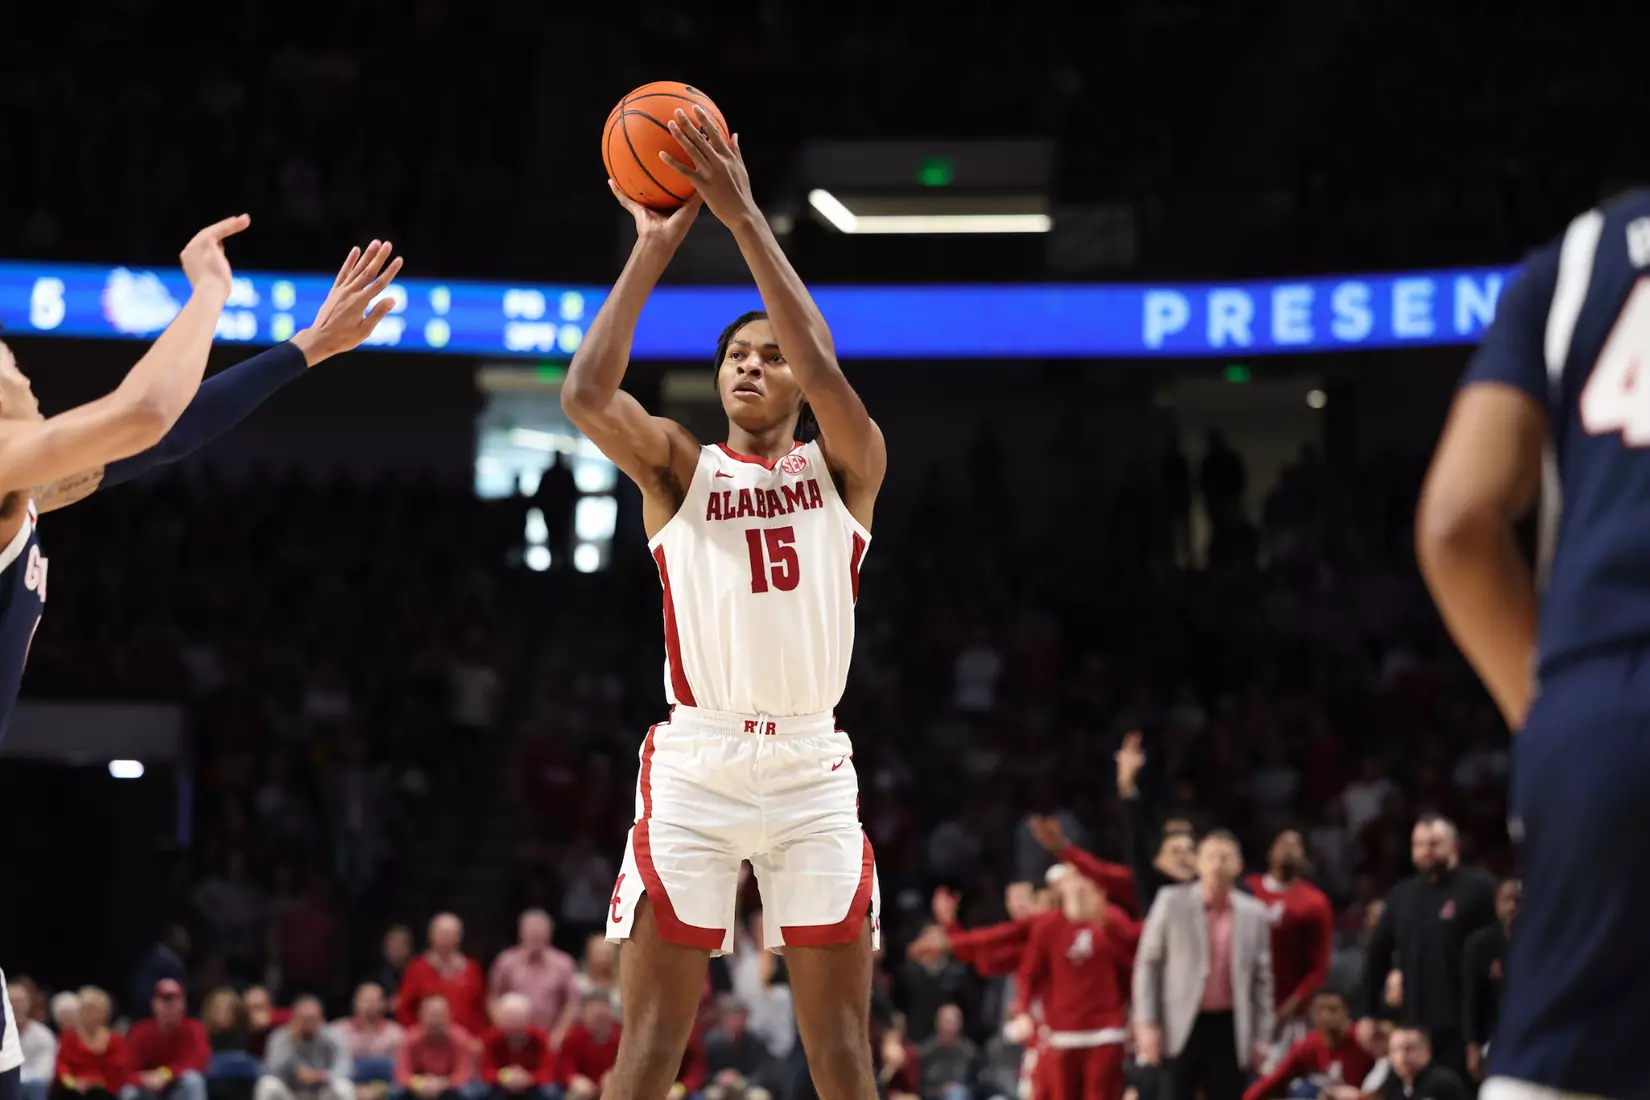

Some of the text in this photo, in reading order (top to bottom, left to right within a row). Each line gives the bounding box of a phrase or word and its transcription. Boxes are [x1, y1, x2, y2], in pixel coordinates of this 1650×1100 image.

[1143, 272, 1502, 350] PRESEN
[706, 478, 824, 521] ALABAMA
[745, 525, 801, 594] 15
